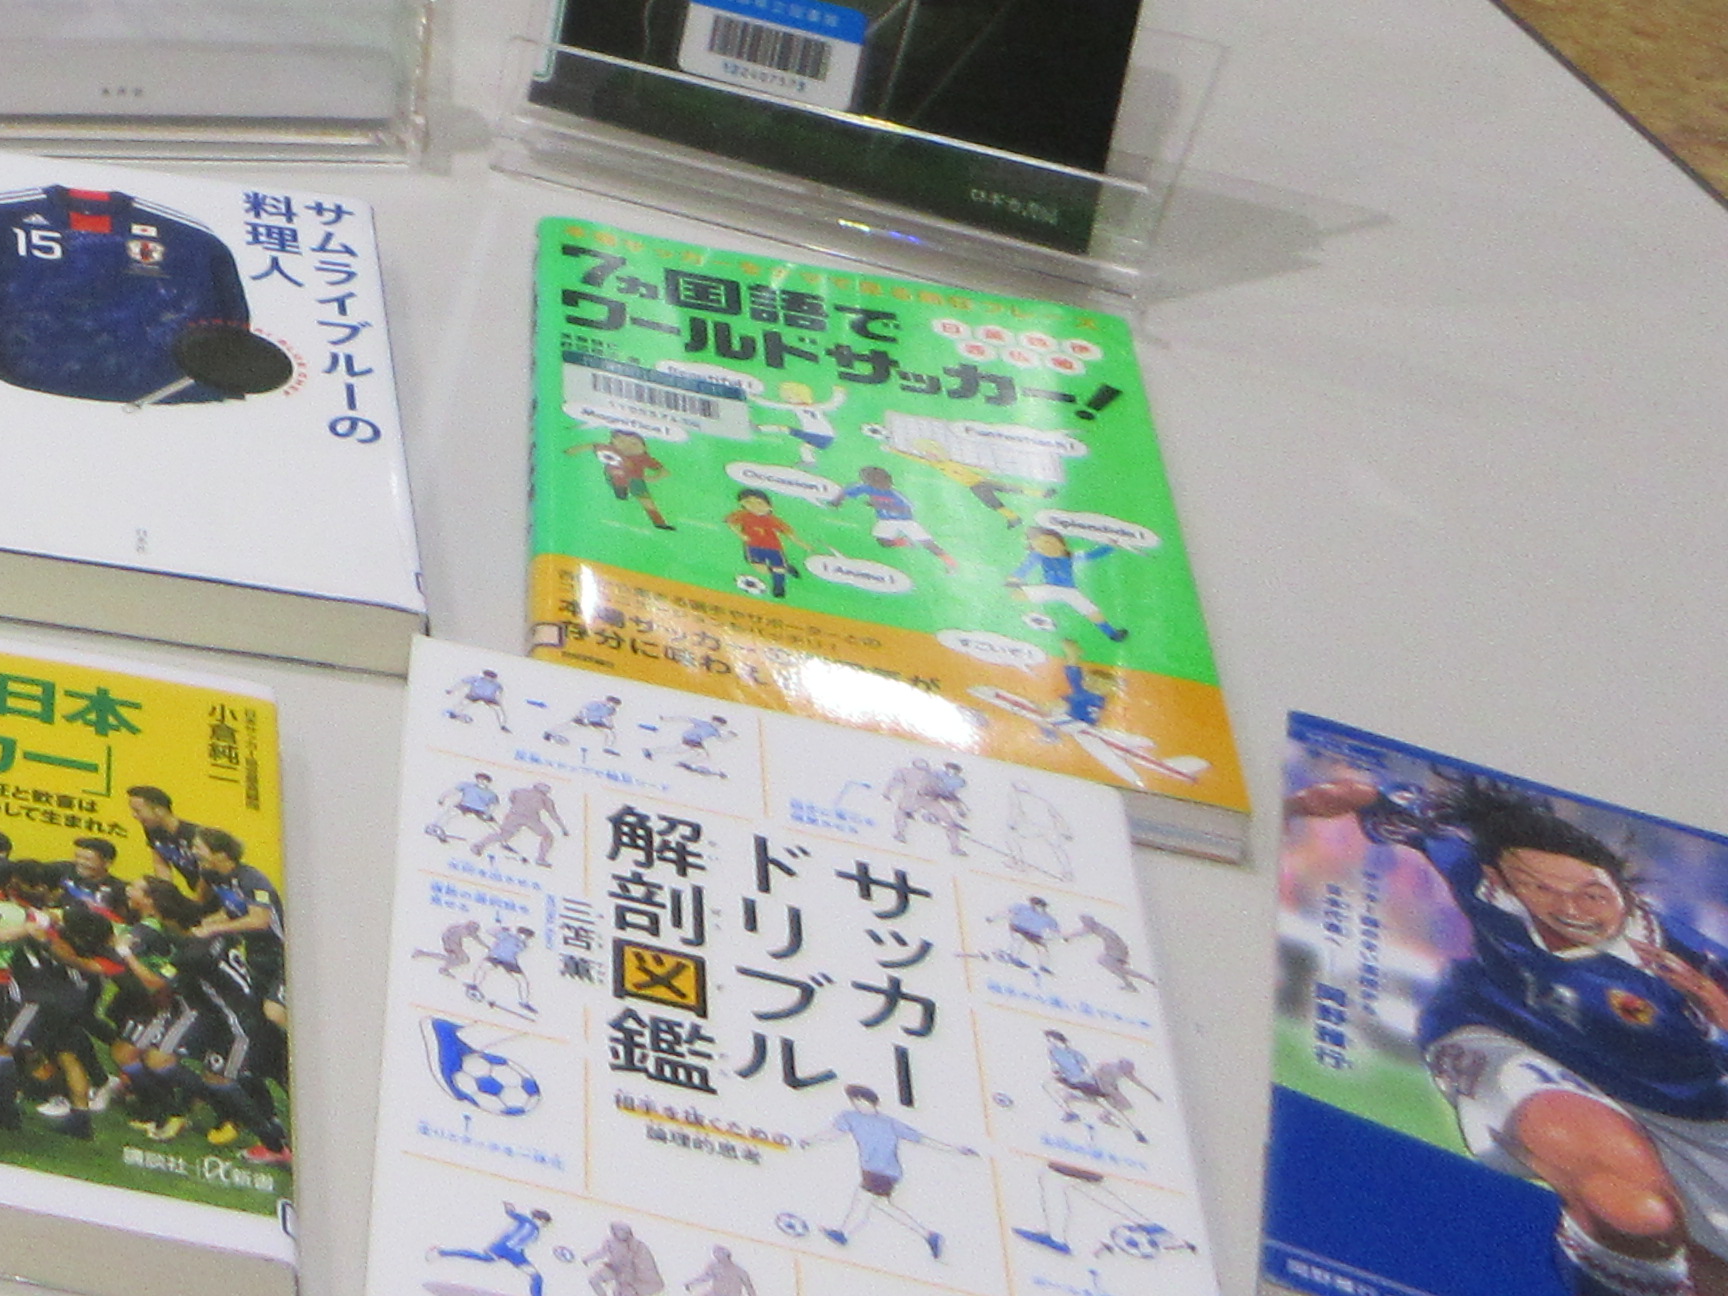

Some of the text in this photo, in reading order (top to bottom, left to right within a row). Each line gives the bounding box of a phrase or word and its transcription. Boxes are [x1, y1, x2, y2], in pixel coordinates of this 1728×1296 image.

[13, 228, 64, 260] 15
[243, 190, 304, 288] 料理人
[303, 200, 382, 444] サムライブルーの
[606, 803, 719, 1098] 解剖図鑑
[732, 832, 838, 1094] ドリブル
[834, 860, 938, 1110] サッカー
